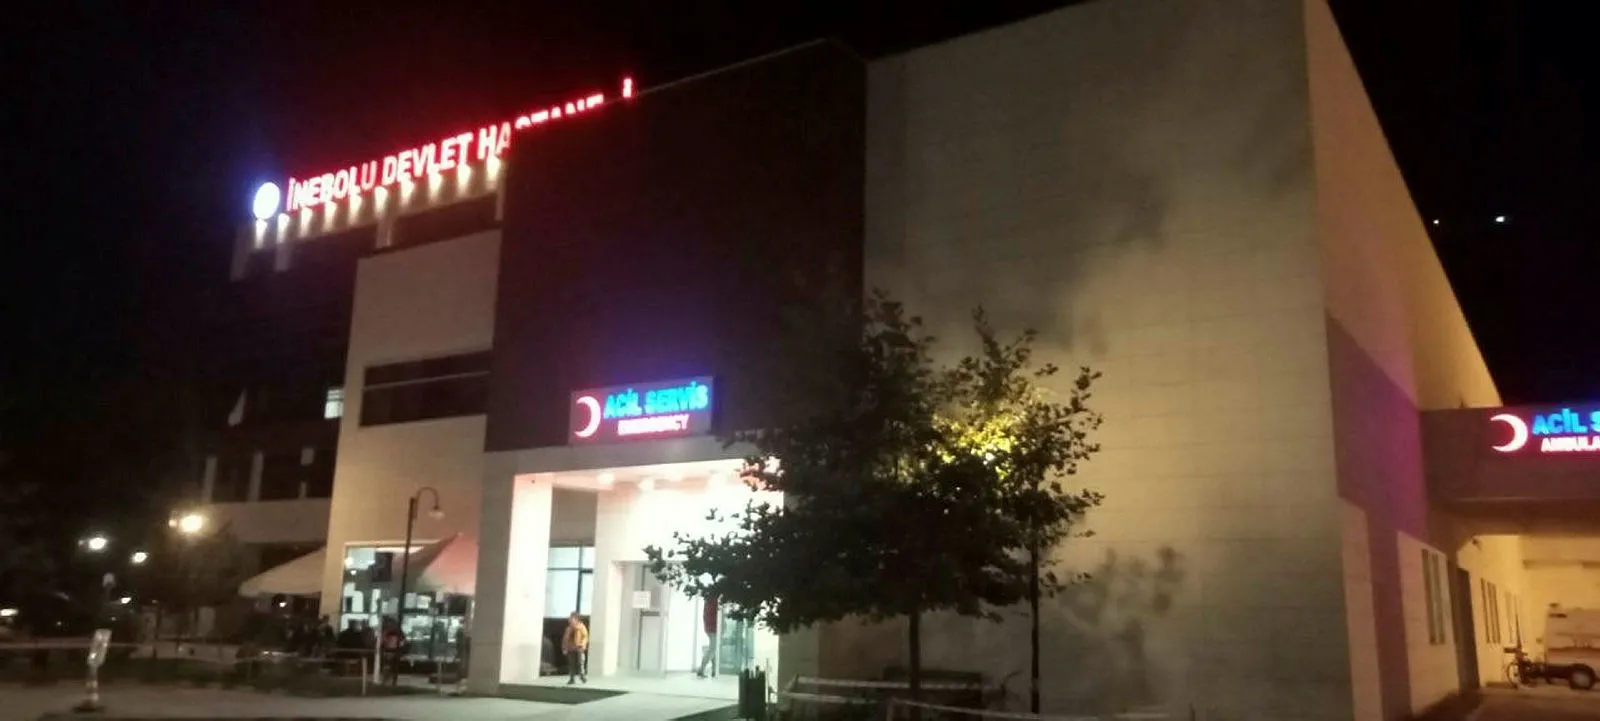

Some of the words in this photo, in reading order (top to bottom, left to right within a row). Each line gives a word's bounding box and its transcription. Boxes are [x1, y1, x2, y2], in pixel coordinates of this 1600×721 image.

[287, 160, 377, 211] İNEBOLU
[382, 132, 474, 186] DEVLET
[603, 388, 642, 419] ACİL
[1532, 408, 1588, 434] ACİL
